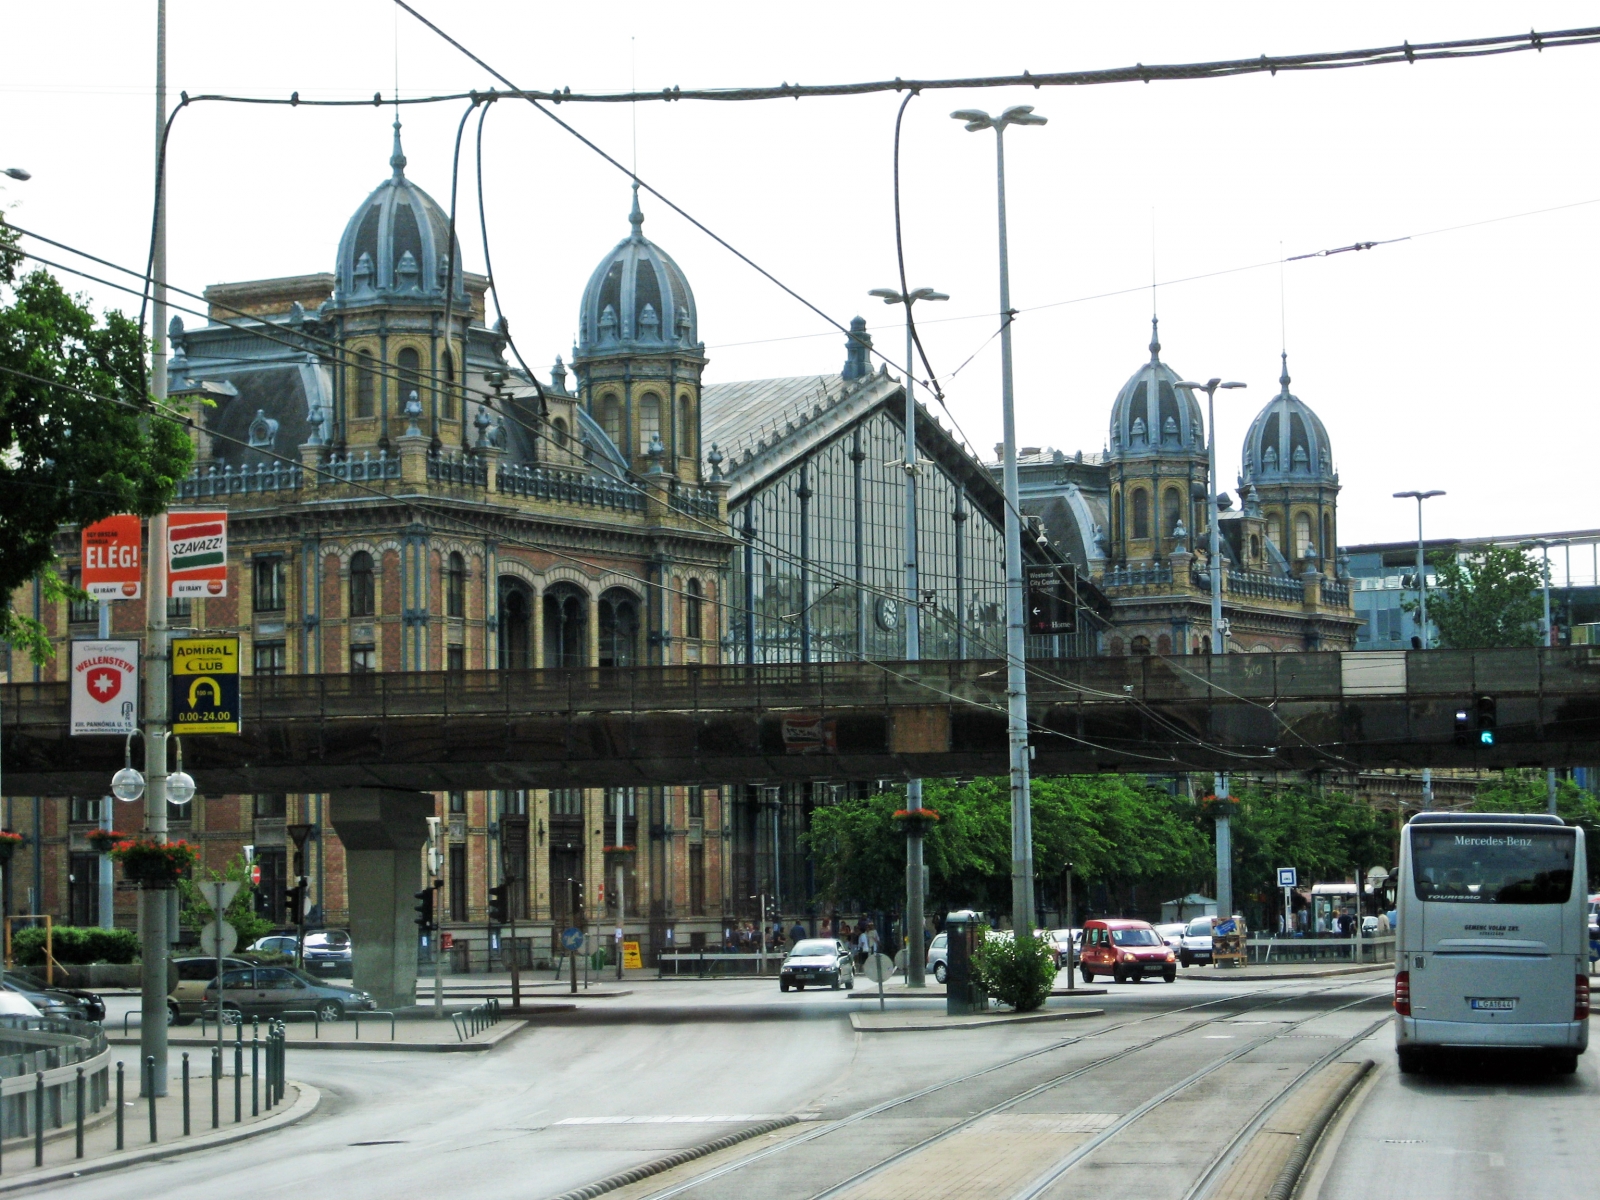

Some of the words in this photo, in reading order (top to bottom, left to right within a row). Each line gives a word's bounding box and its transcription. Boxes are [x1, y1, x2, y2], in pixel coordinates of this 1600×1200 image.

[172, 537, 223, 556] SZAVAZZ!
[86, 540, 138, 569] ELÉG!
[100, 586, 117, 594] IRÁNY
[185, 583, 202, 592] IRÁNY
[176, 645, 233, 657] ADMIRAL
[75, 655, 135, 674] WELLENSTEYN
[185, 657, 223, 671] CLUB
[178, 711, 231, 722] 0.00-24.00
[86, 720, 116, 728] PANNÓNIA
[1454, 835, 1532, 847] Mercedes-Benz
